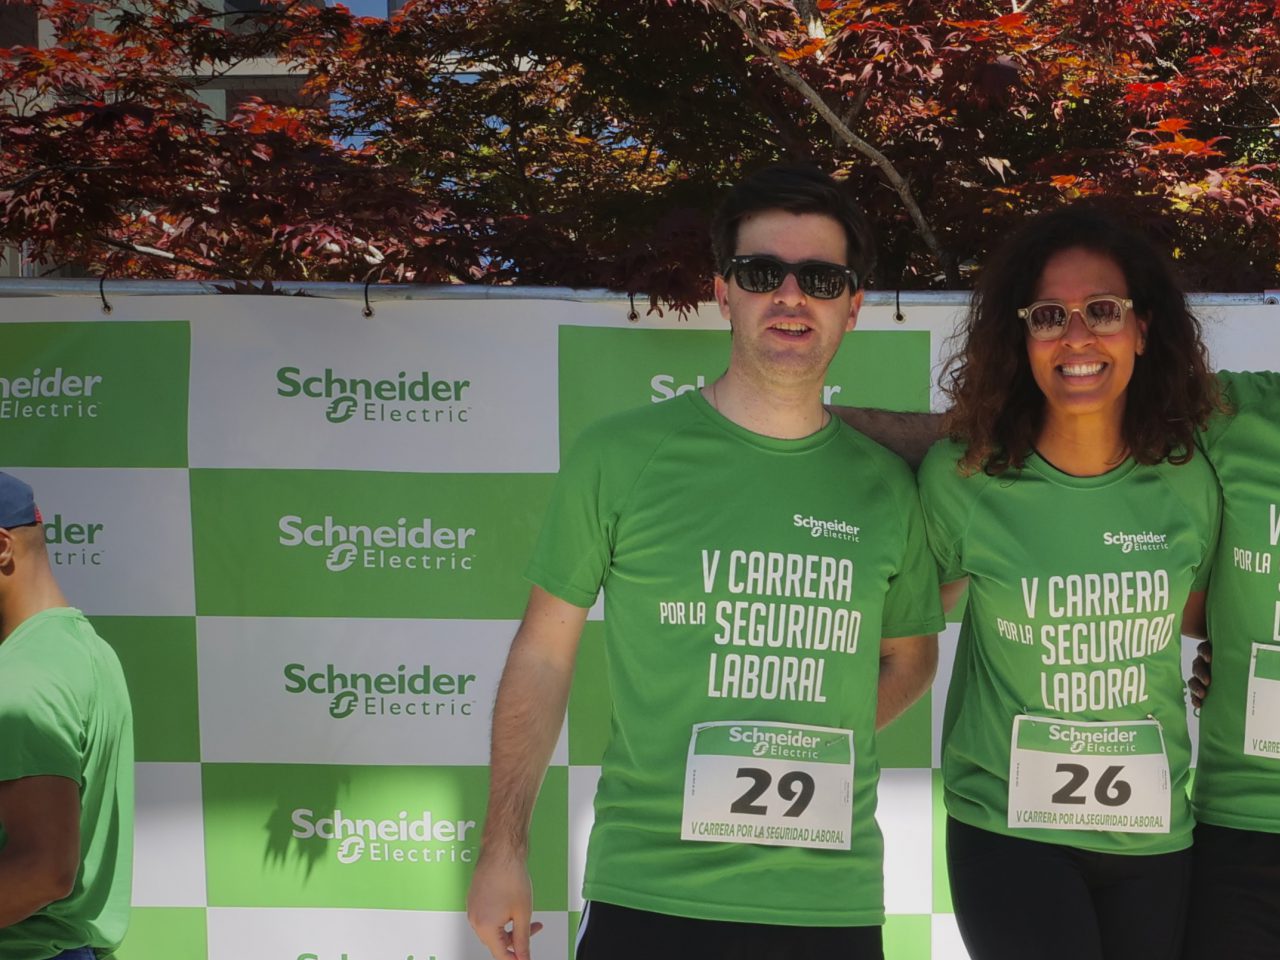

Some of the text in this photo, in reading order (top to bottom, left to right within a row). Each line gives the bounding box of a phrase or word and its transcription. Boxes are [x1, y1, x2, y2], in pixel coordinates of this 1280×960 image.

[276, 367, 470, 401] Schneider
[0, 401, 98, 418] Electric
[364, 404, 469, 423] Electric
[279, 516, 475, 549] Schneider
[793, 514, 860, 535] Schneider
[824, 530, 860, 542] Electric
[1103, 531, 1166, 546] Schneider
[1134, 542, 1169, 551] Electric
[364, 552, 472, 570] Electric
[1233, 547, 1252, 572] POR
[1255, 552, 1271, 574] LA
[702, 550, 853, 602] V CARRERA
[1021, 569, 1169, 619] V CARRERA
[660, 600, 862, 654] POR LA SEGURIDAD
[997, 613, 1175, 665] POR LA SEGURIDAD
[284, 664, 476, 695] Schneider
[708, 653, 827, 702] LABORAL
[1041, 663, 1149, 713] LABORAL
[365, 698, 471, 716] Electric
[729, 727, 821, 748] Schneider
[1049, 725, 1137, 743] Schneider
[1252, 739, 1258, 750] V
[771, 746, 819, 759] Electric
[1087, 743, 1136, 752] Electric
[730, 767, 815, 818] 29
[1051, 763, 1132, 807] 26
[292, 809, 476, 842] Schneider
[1016, 810, 1164, 828] V CARRERA POR LA SEGURIDAD LABORAL
[691, 822, 845, 844] V CARRERA POR LA SEGURIDAD LABORAL
[371, 843, 471, 862] Electric
